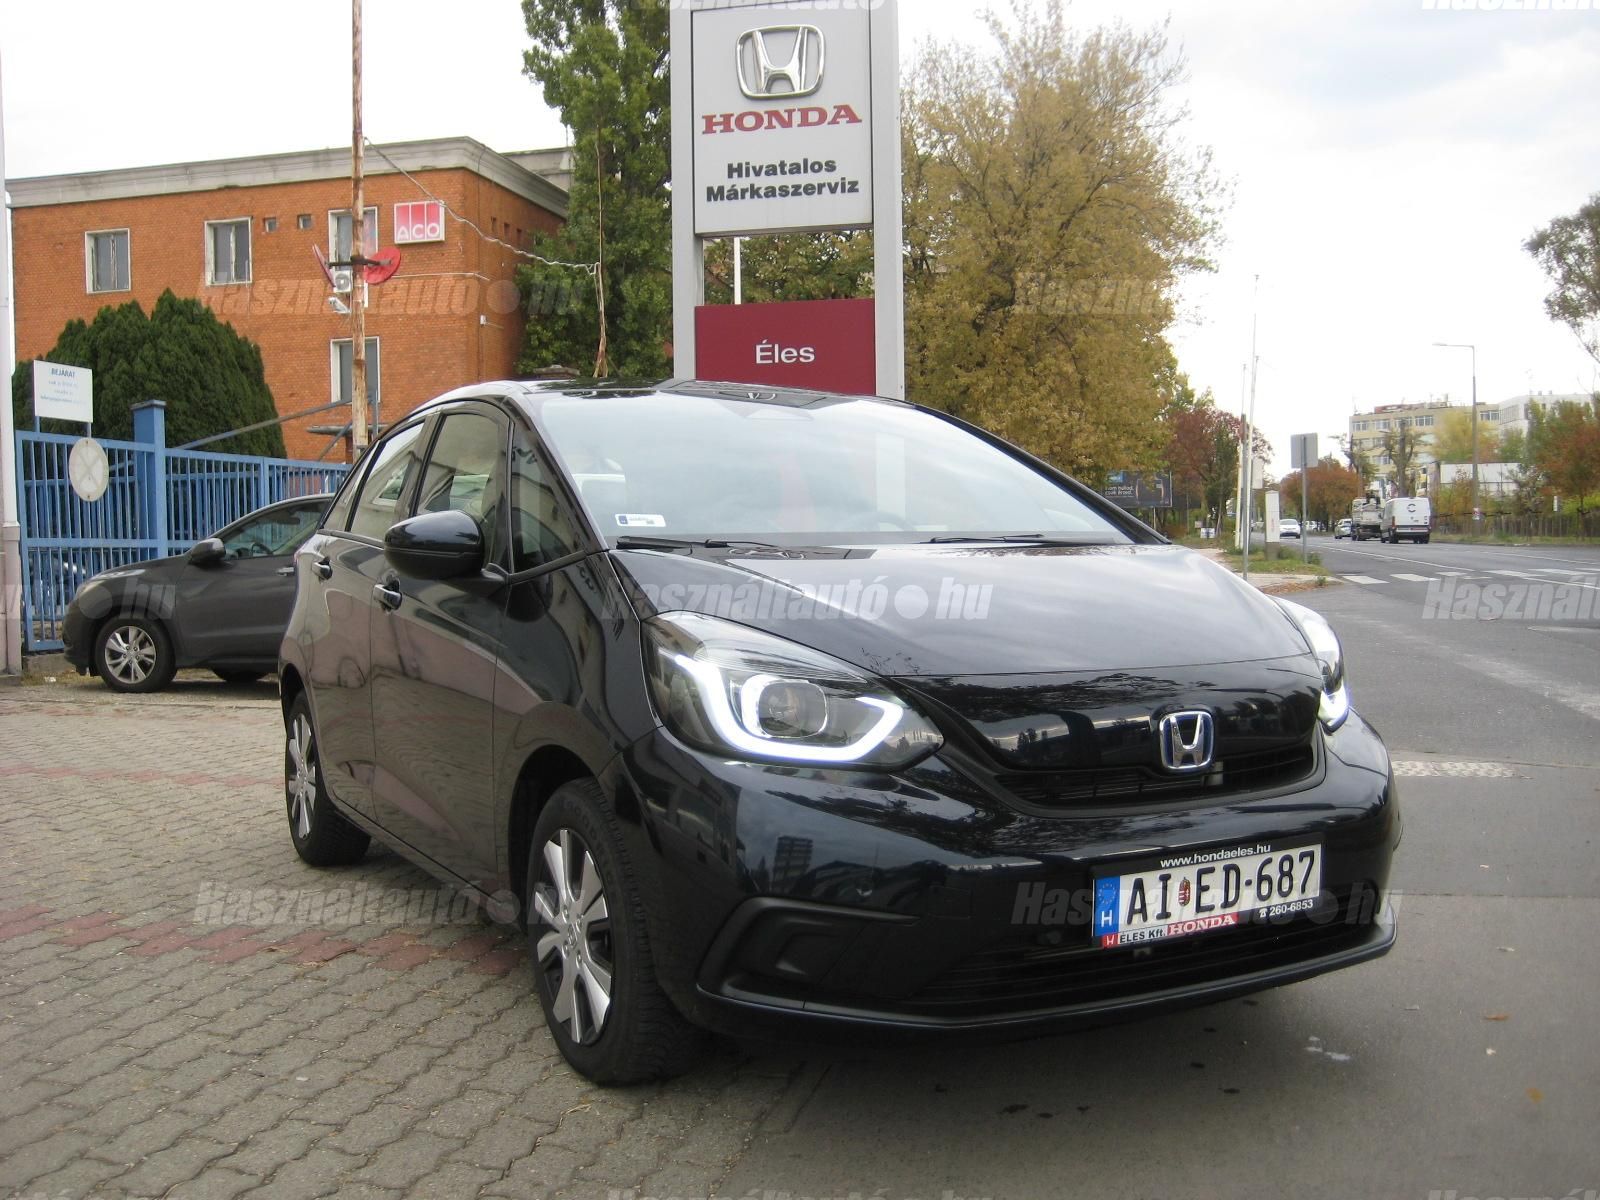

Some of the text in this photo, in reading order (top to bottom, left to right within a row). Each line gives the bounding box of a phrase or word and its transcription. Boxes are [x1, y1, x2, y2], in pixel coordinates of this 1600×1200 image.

[702, 104, 862, 135] HONDA
[727, 158, 837, 180] Hivatalos
[706, 177, 860, 203] Márkaszerviz
[397, 223, 440, 241] ACO
[755, 339, 816, 365] Éles
[1160, 844, 1271, 868] www.hondaeles.hu
[1269, 899, 1314, 918] 260-6853
[1169, 914, 1235, 936] HONDA
